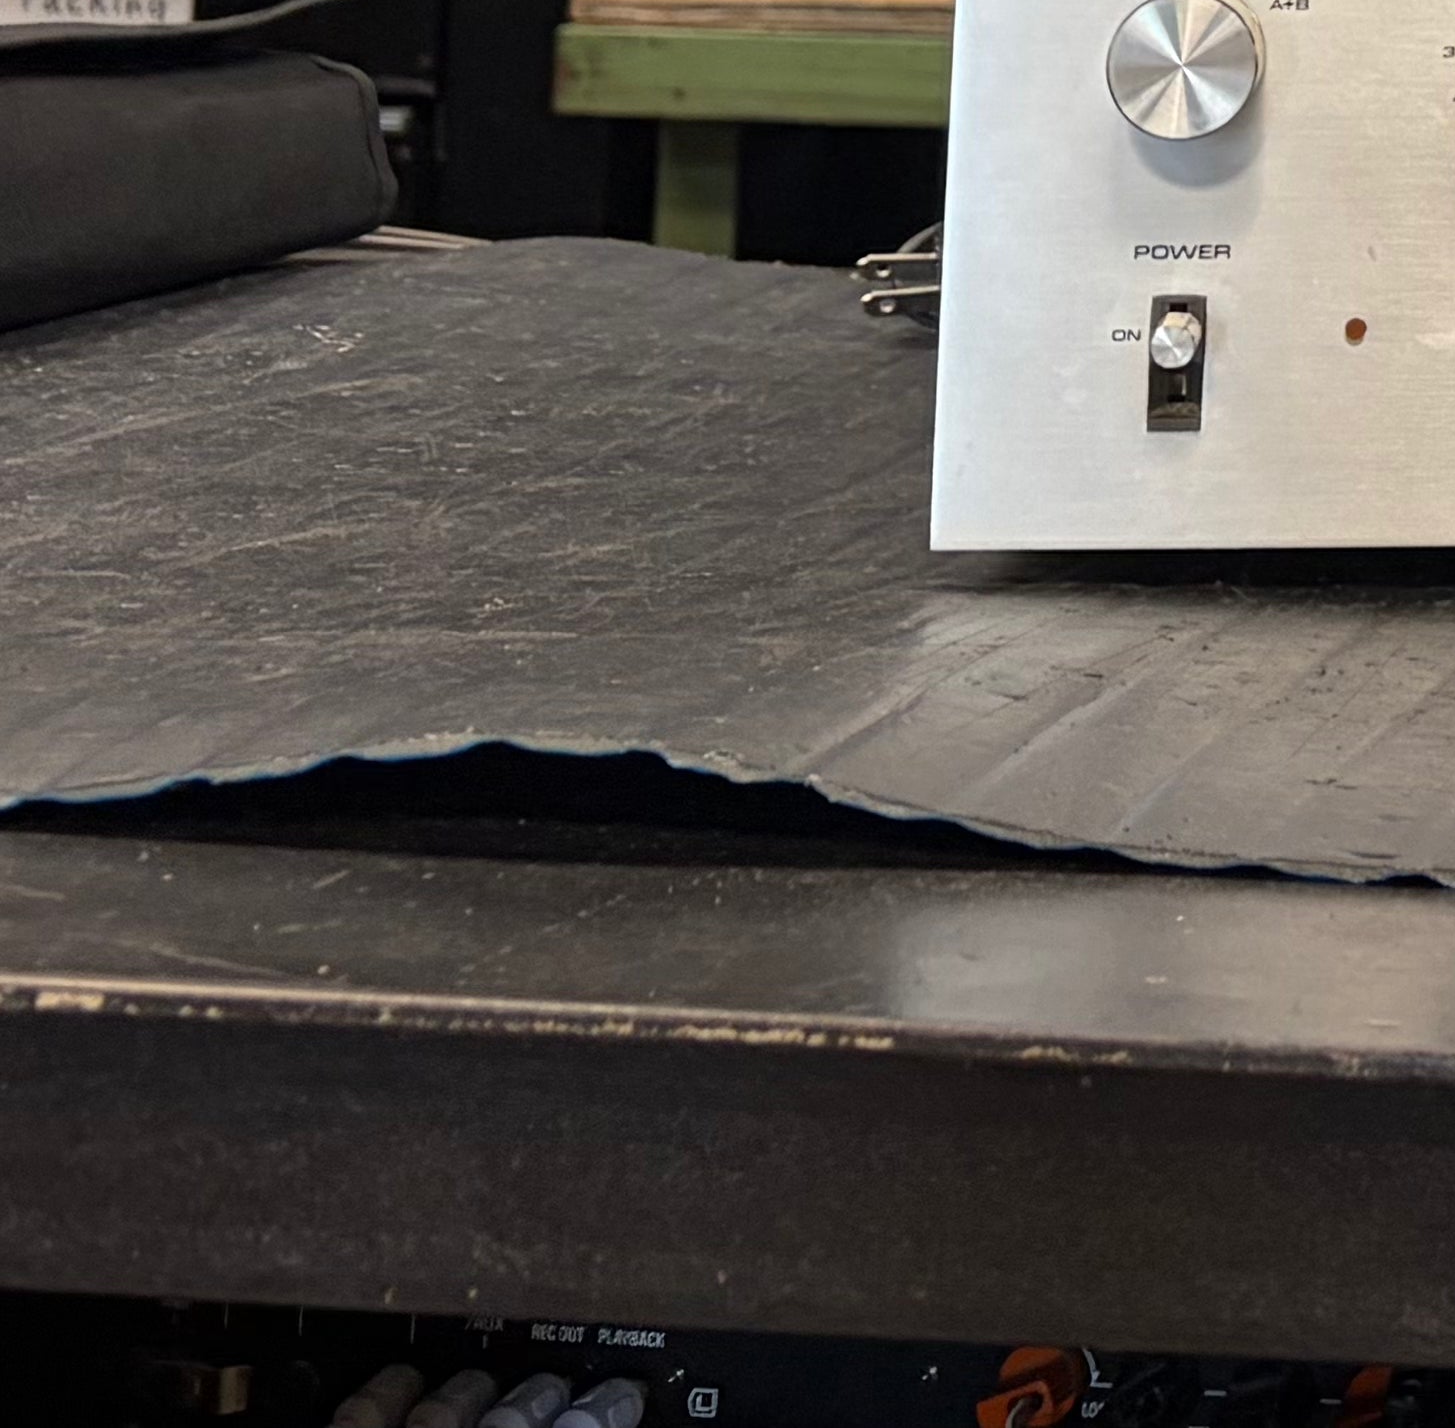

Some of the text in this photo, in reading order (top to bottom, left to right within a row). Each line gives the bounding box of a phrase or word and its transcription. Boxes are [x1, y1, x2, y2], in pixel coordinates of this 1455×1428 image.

[1442, 46, 1455, 58] 3
[1133, 244, 1232, 261] POWER
[1111, 328, 1142, 343] ON
[558, 1325, 585, 1344] OUT
[597, 1327, 667, 1349] PLAYBACK
